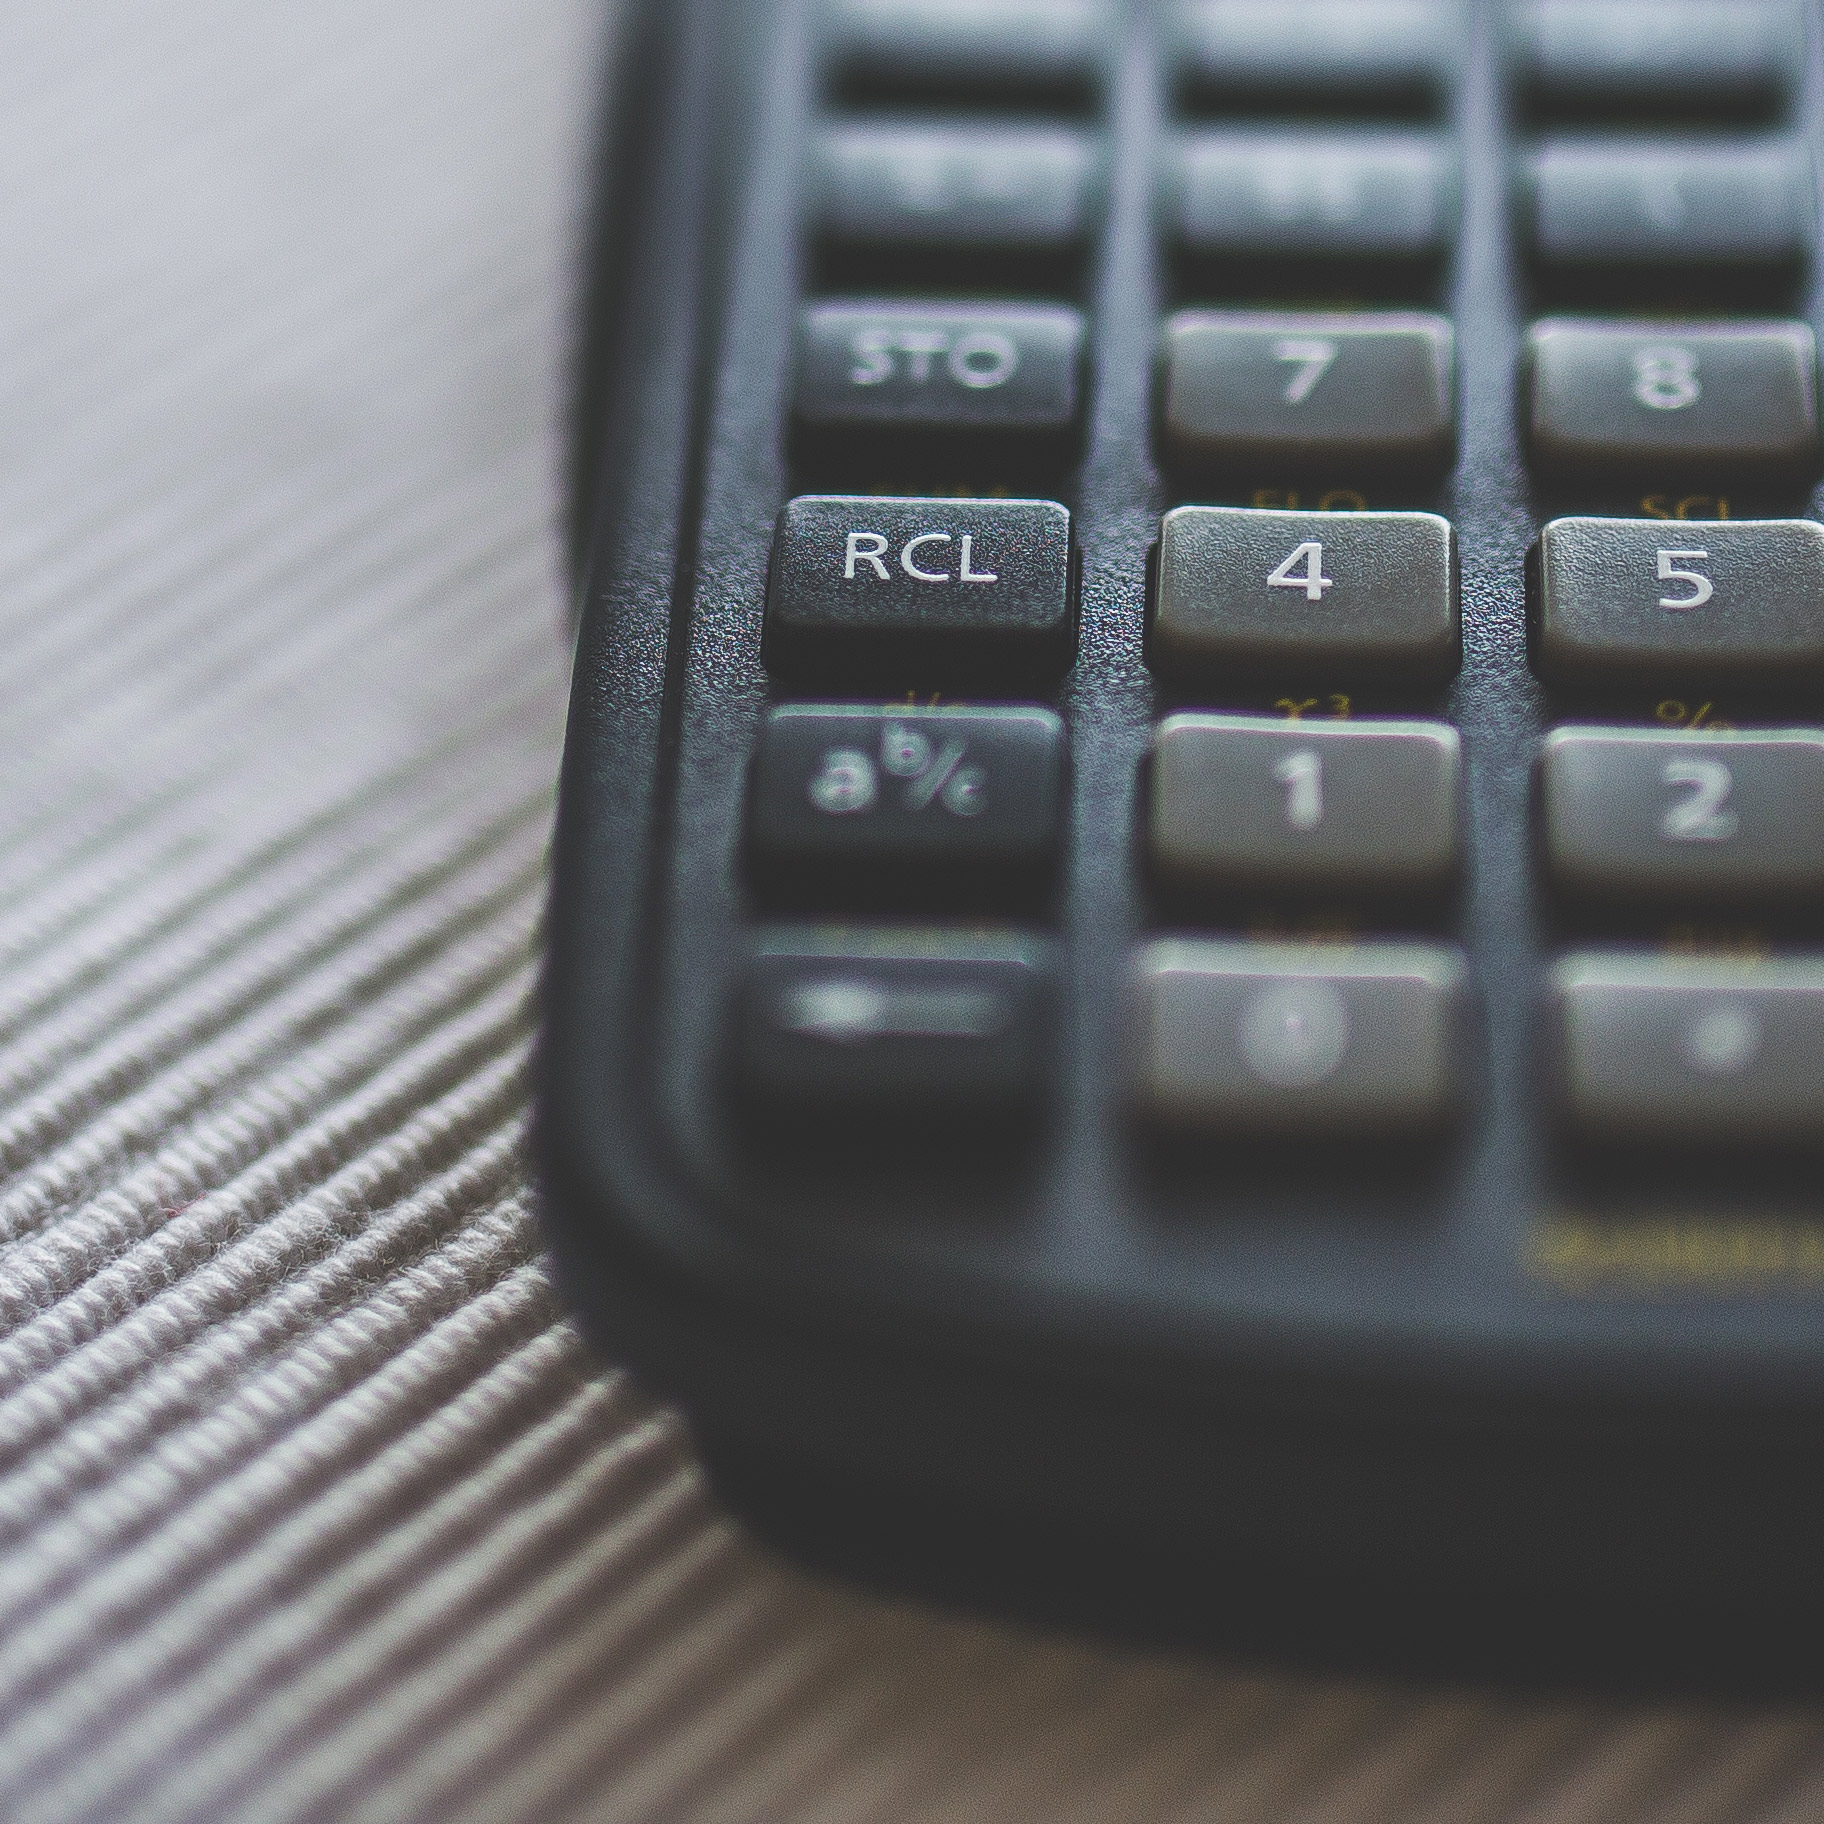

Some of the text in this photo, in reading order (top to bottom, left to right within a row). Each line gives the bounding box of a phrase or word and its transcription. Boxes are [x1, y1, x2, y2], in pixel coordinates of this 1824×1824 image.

[850, 329, 1020, 389] STO
[1272, 339, 1338, 404] 7
[1631, 344, 1701, 412] 8
[843, 532, 999, 583] RCL
[1266, 541, 1333, 602] 4
[1654, 549, 1715, 610] 5
[1272, 751, 1323, 831] 1
[1659, 757, 1739, 843] 2
